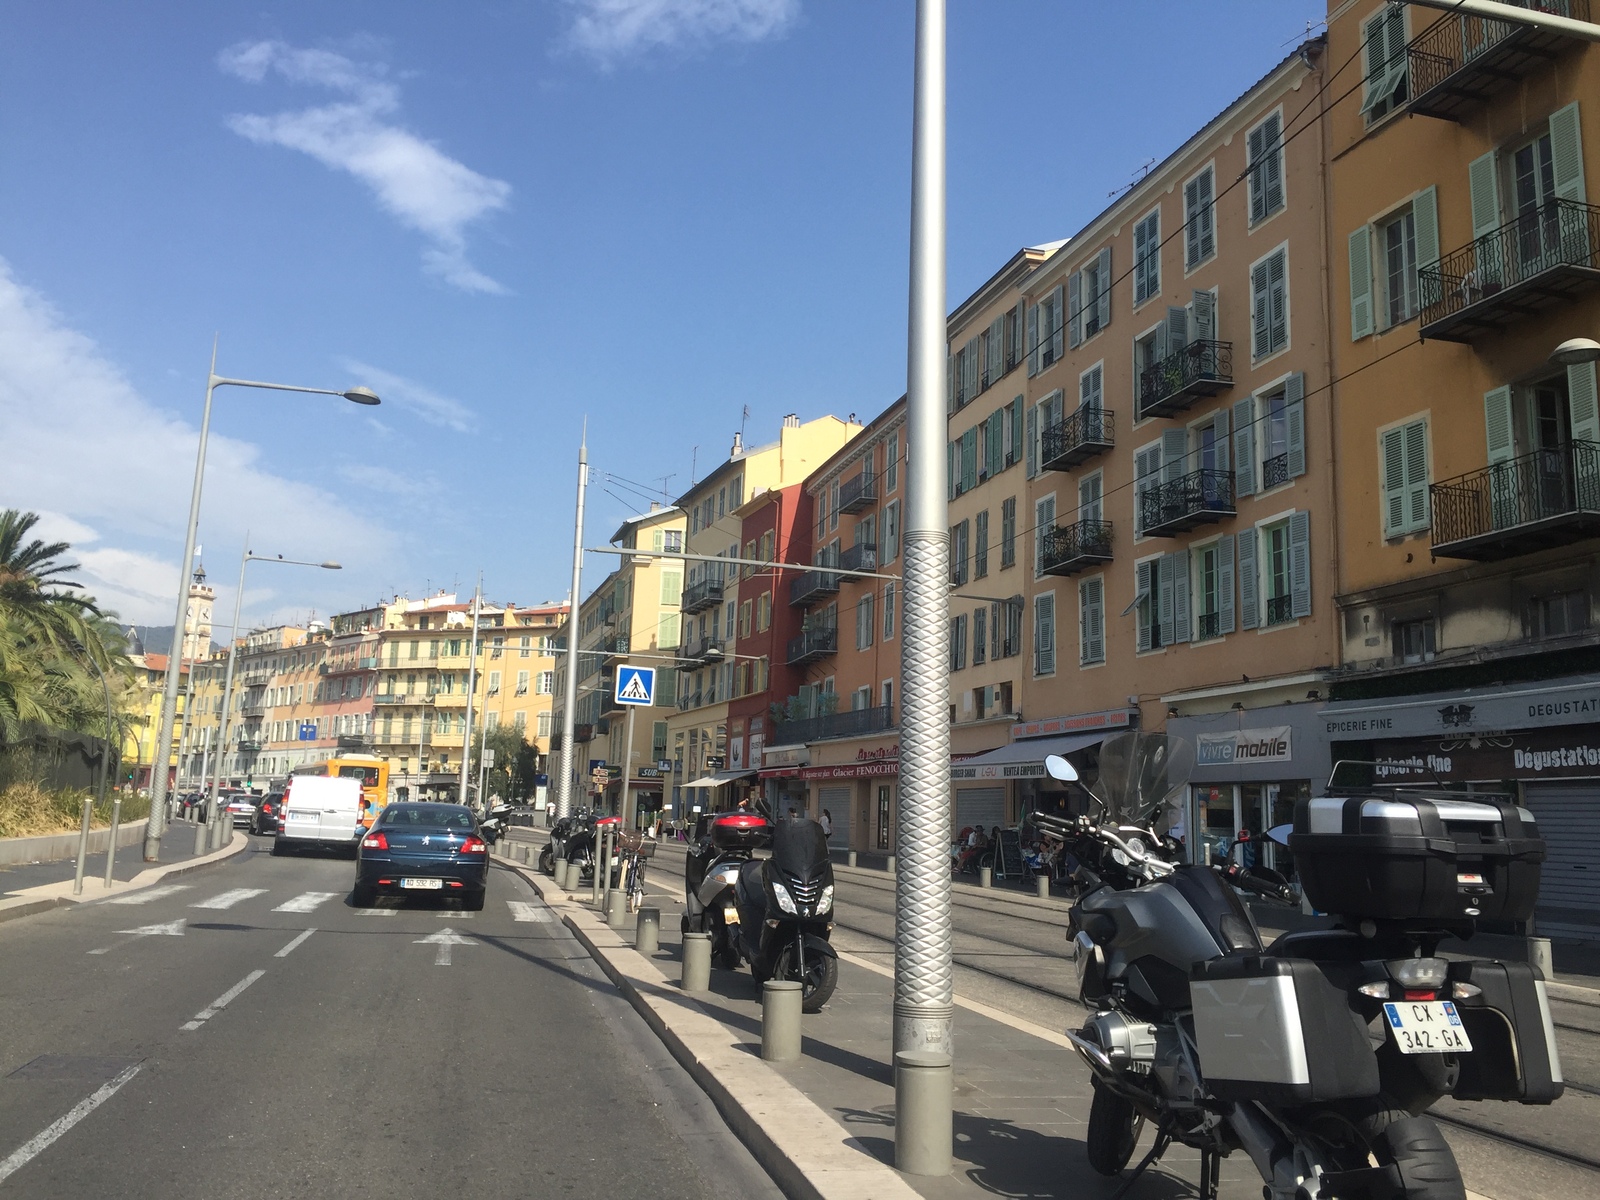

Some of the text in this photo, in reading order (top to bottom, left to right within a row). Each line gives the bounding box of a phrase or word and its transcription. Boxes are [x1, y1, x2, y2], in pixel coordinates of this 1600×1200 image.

[1326, 718, 1393, 733] EPICERIE FINE
[1202, 738, 1287, 760] vivre mobile
[1426, 754, 1451, 773] fine
[1514, 745, 1600, 771] Dégustatio
[833, 768, 854, 777] Glacier
[857, 763, 899, 775] FENOCCHIO
[1020, 765, 1045, 775] EMPORTER
[364, 777, 374, 785] 14
